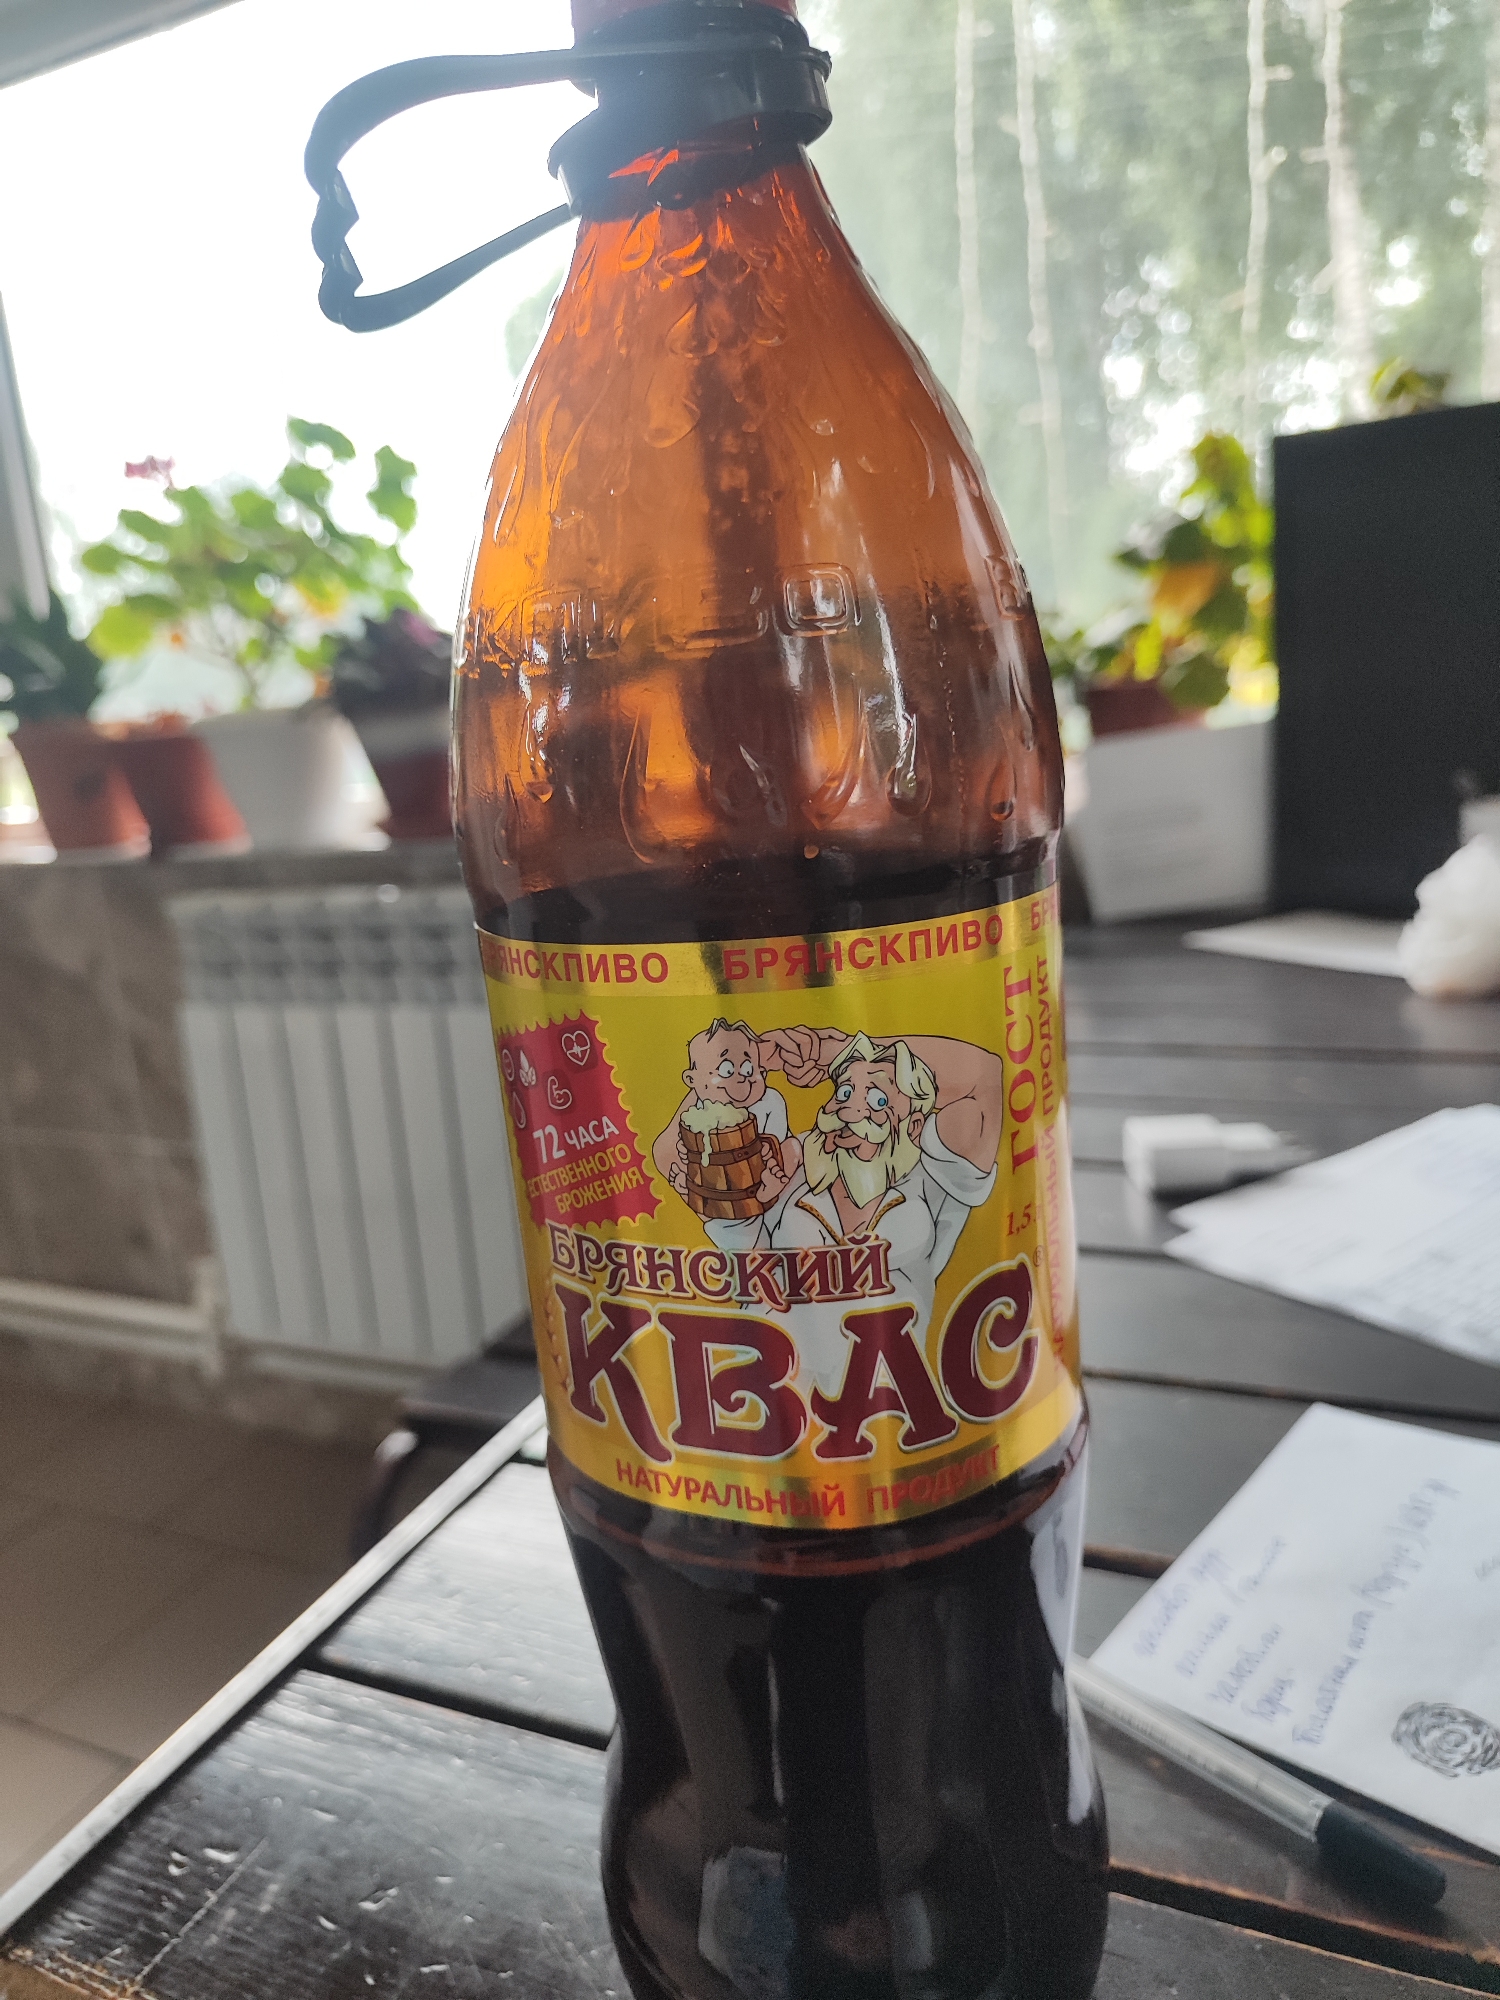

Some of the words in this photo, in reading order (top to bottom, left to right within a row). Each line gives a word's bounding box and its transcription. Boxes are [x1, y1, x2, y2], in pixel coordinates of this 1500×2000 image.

[722, 914, 1003, 981] БРЯНСКПИВО
[1003, 965, 1039, 1175] ГОСТ
[1036, 955, 1056, 1117] ПРОДУКТ
[526, 1143, 632, 1198] ЕСТЕСТВЕННОГО
[532, 1124, 566, 1164] 72
[564, 1115, 620, 1151] ЧАСА
[555, 1166, 645, 1214] БРОЖЕНИЯ
[546, 1219, 896, 1312] БРЯНСКИЙ
[553, 1252, 1040, 1466] КВАС
[616, 1458, 846, 1517] НАТУРАЛЬНЫЙ
[867, 1444, 1001, 1514] ПРОДУКТ
